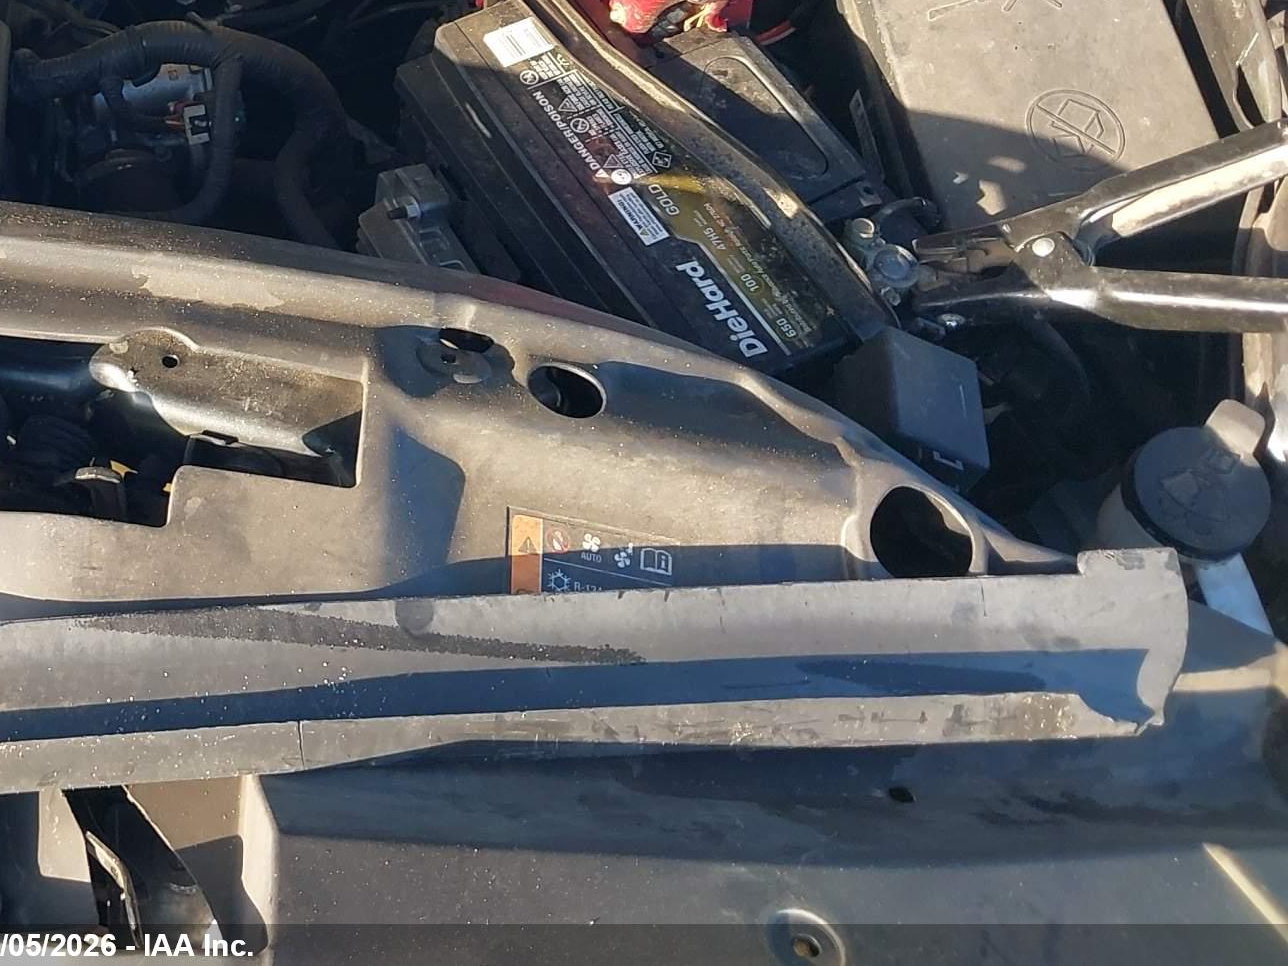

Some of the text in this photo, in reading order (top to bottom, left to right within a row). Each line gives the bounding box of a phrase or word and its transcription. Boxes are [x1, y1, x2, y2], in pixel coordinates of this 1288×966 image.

[532, 90, 600, 170] DANGER/POISON
[646, 183, 680, 215] GOLD
[739, 272, 759, 292] 100
[674, 257, 768, 359] DieHard
[776, 317, 797, 338] 650
[581, 552, 602, 563] AUTO
